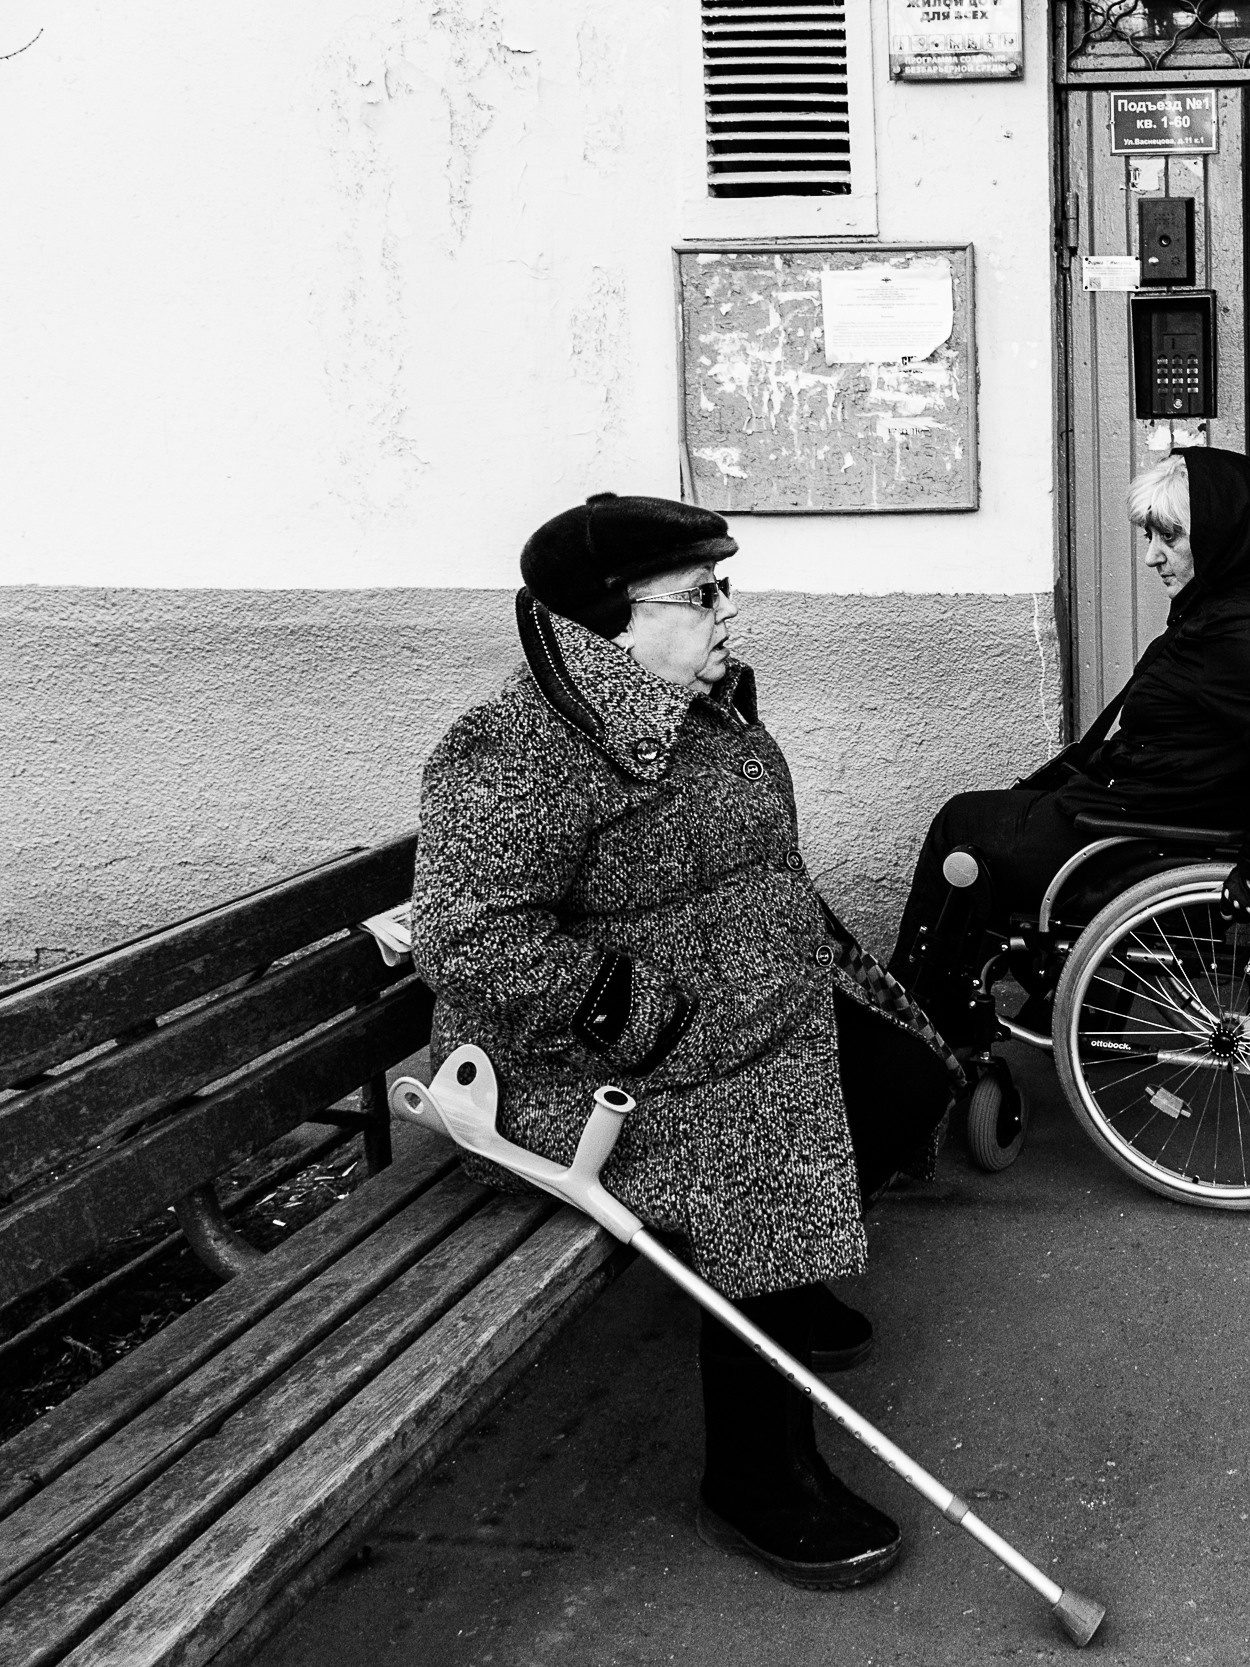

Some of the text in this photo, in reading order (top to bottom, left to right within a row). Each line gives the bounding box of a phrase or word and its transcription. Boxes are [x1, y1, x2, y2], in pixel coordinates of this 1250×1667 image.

[1117, 97, 1210, 114] Подъезд №1
[1136, 115, 1191, 129] кв. 1-60
